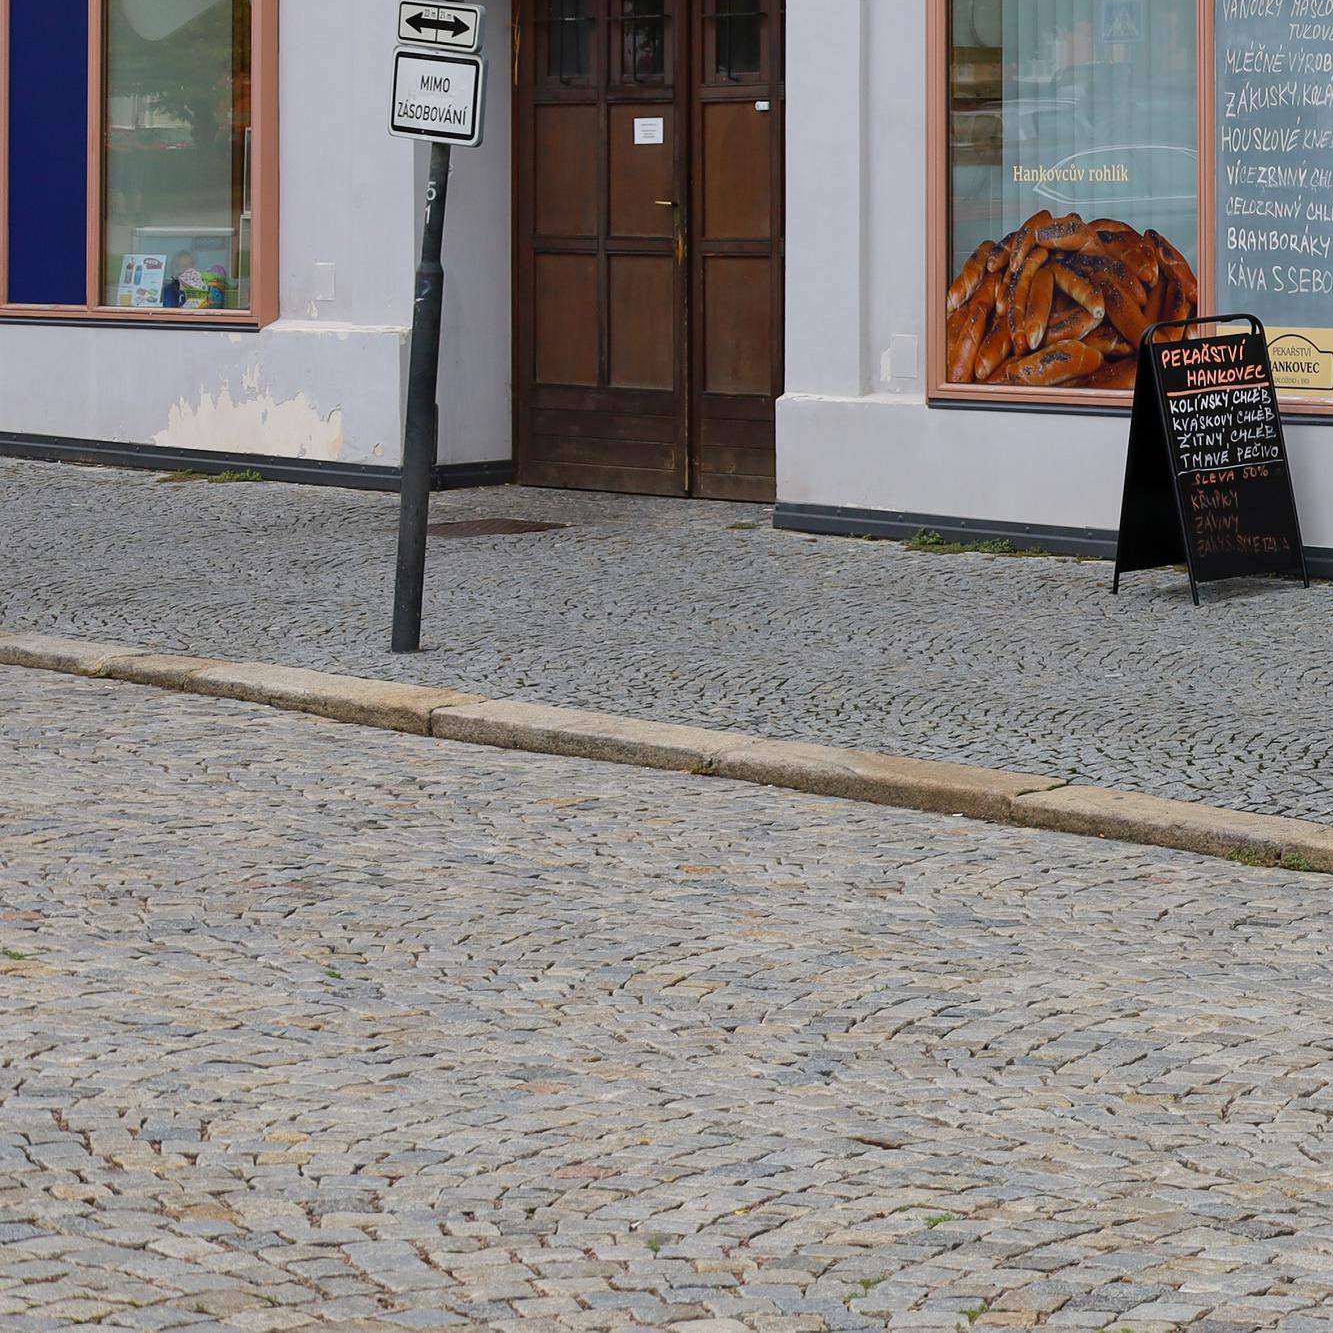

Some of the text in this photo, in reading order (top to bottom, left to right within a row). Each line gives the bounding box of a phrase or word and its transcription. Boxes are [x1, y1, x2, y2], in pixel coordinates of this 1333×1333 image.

[1225, 41, 1285, 75] MLÉČNÉ
[420, 74, 451, 93] MIMO
[397, 99, 467, 126] ZÁSOBOVÁNÍ
[1221, 116, 1300, 152] HOUSKOVÉ
[1013, 164, 1129, 182] Hankovcův rohlík
[1226, 159, 1308, 187] VÍCEZRNNÝ
[1226, 195, 1302, 218] CELOZRNNÝ
[1227, 225, 1331, 259] BRAMBORÁKY
[1228, 256, 1267, 291] KÁVA
[1161, 339, 1246, 369] PEKAŘSTVÍ
[1272, 345, 1311, 357] PEKAŘSTVÍ
[1186, 364, 1266, 387] HANKOVEC
[1270, 361, 1320, 374] ANKOVEC
[1169, 386, 1272, 414] KOLÍNSKÝ CHLÉB
[1172, 404, 1275, 431] KVÁSKOVÝ CHLÉB
[1177, 423, 1276, 449] ŽITNÝ CHLÉB
[1180, 442, 1279, 468] TMAVÉ PEČIVO
[1193, 465, 1269, 485] SLEVA 50%
